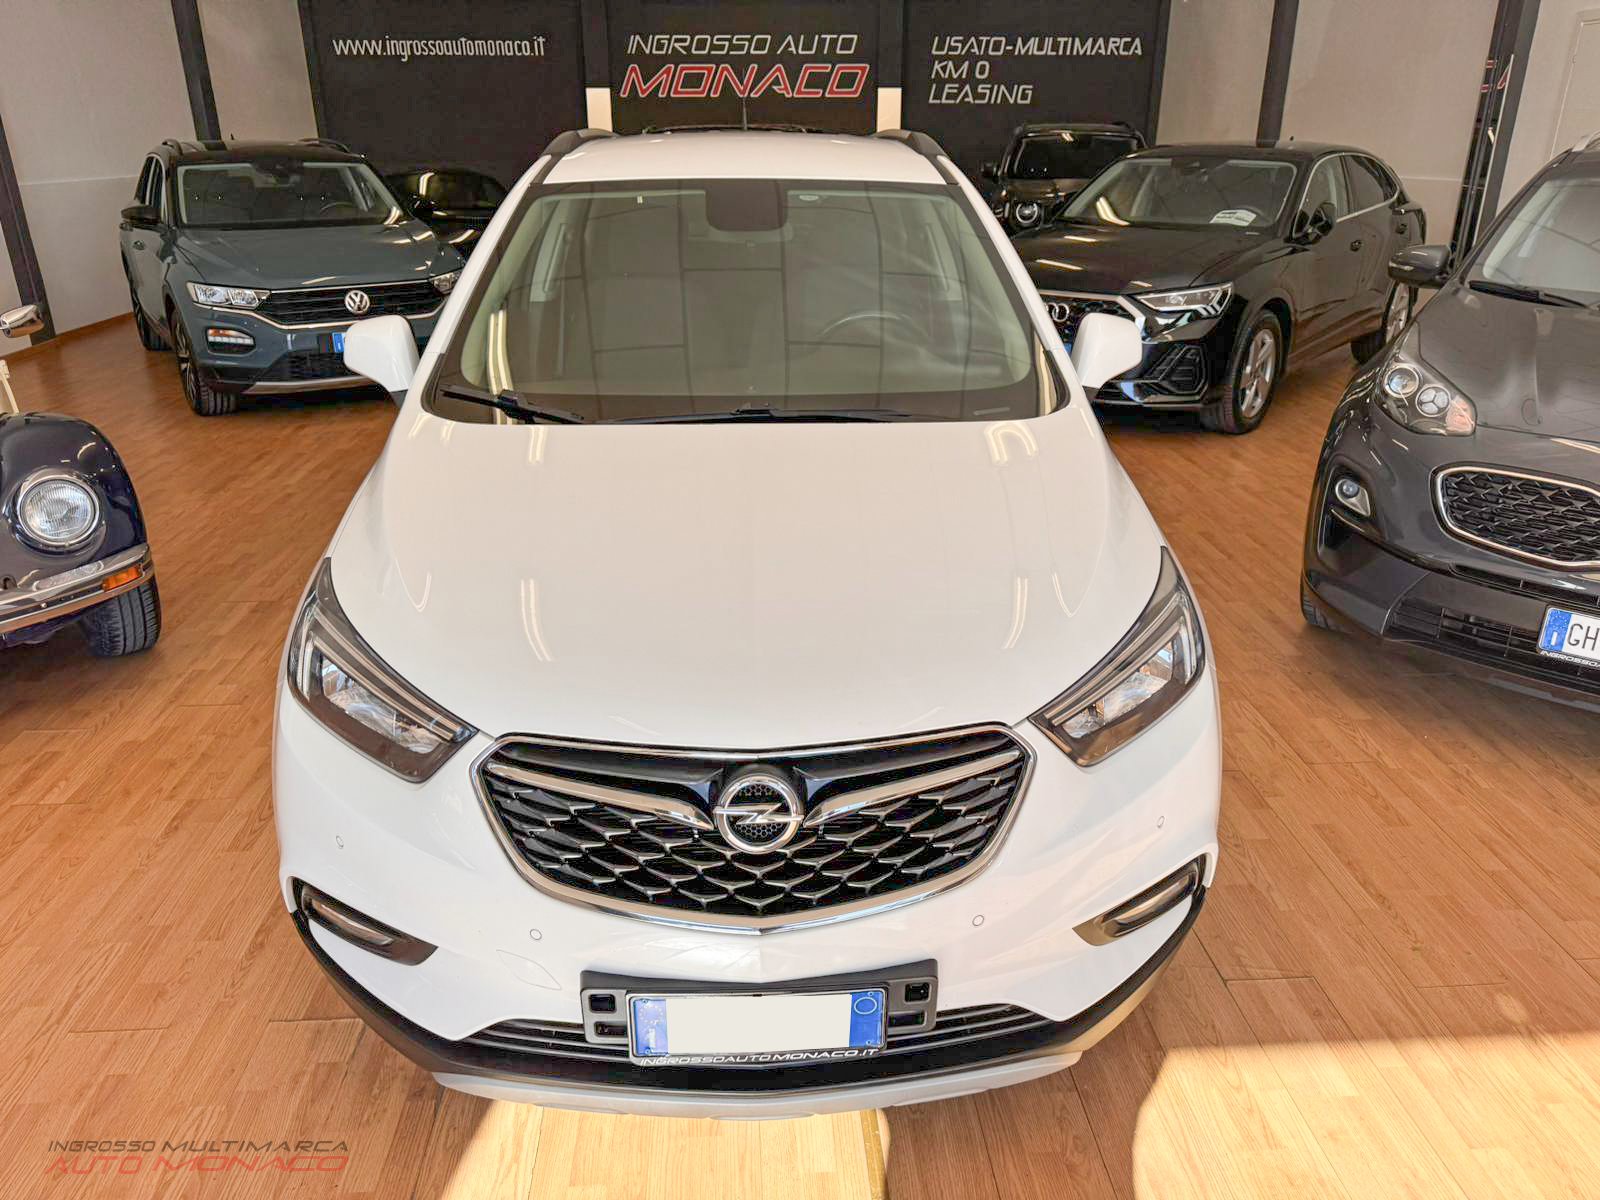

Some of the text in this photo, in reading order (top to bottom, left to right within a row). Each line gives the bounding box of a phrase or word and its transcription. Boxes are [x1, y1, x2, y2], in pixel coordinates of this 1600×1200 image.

[332, 36, 547, 62] www.ingrossoautomonaco.it
[627, 34, 858, 55] INGROSSO AUTO
[931, 36, 1143, 56] USATO-MULTIMARCA
[931, 60, 969, 79] KM
[620, 63, 870, 99] MONACO
[928, 83, 1034, 104] LEASING
[1540, 650, 1600, 668] INGROSSO
